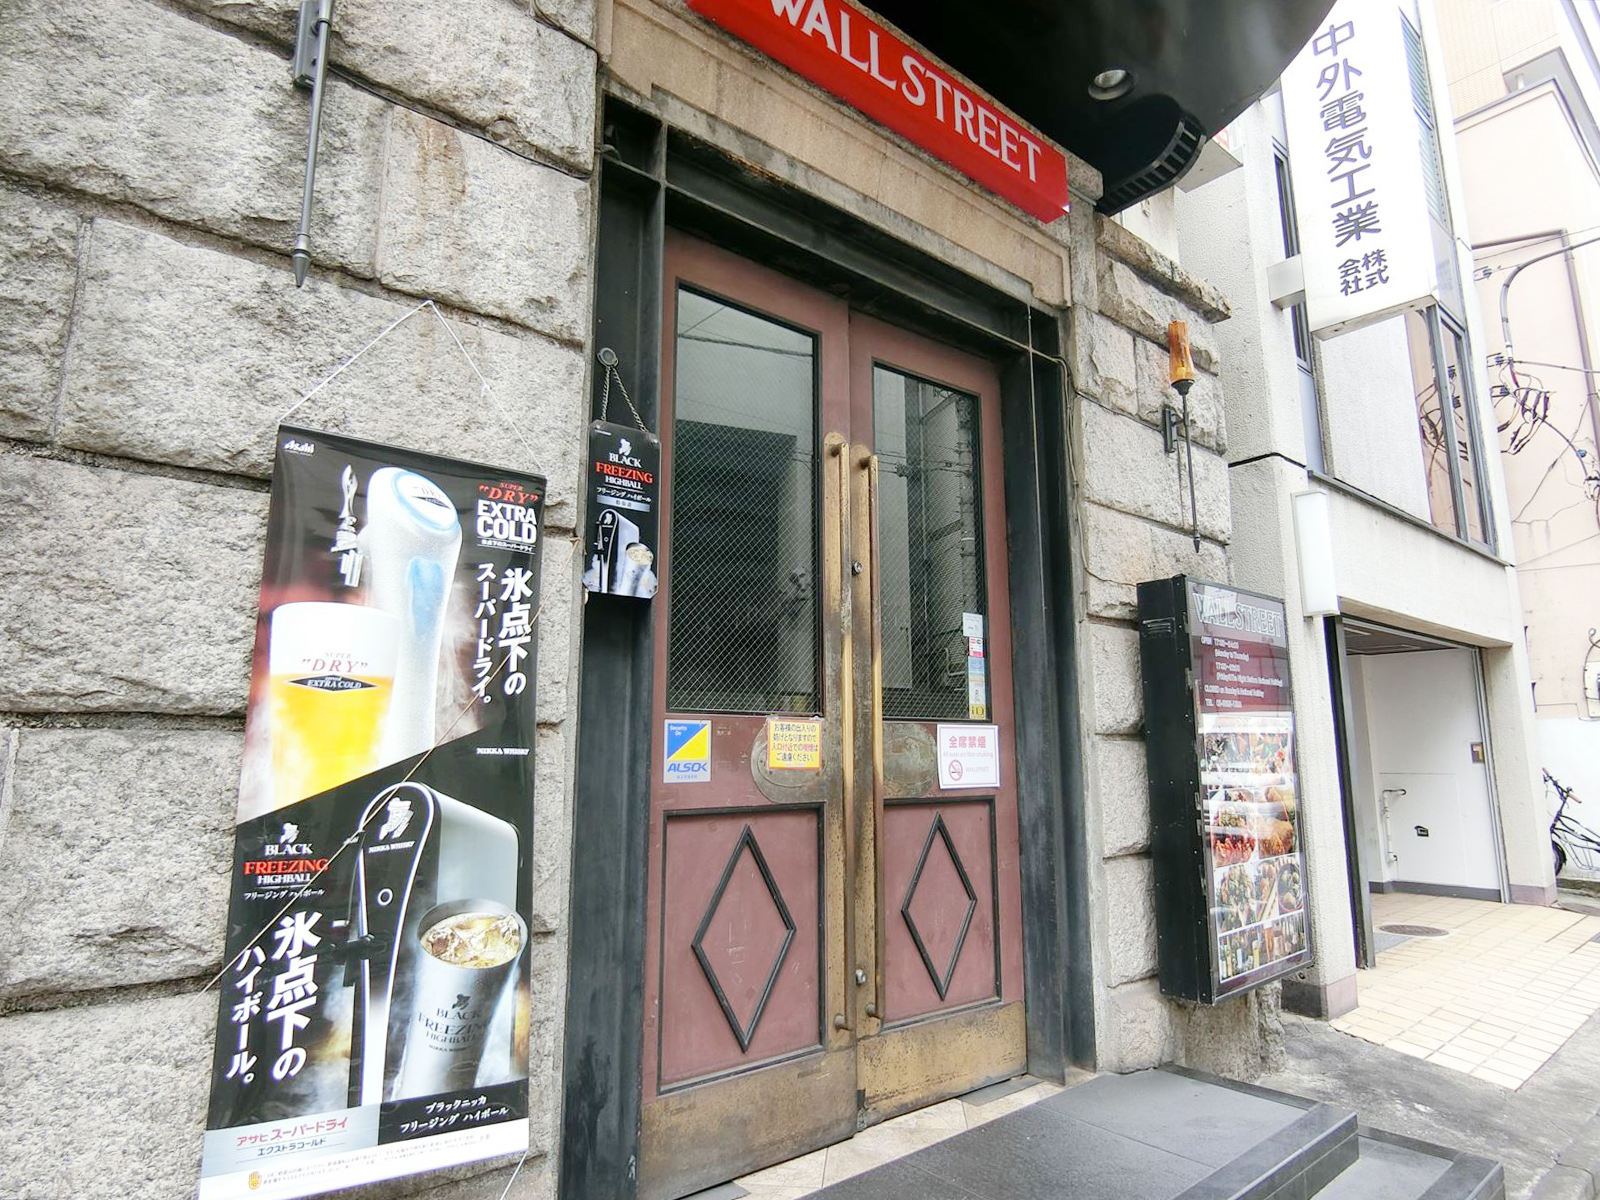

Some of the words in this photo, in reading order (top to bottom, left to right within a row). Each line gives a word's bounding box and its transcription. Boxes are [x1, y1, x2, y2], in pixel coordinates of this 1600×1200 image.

[902, 55, 1042, 183] STREET
[1311, 20, 1382, 248] 中外電気工業
[284, 439, 315, 454] Asahi
[609, 452, 642, 468] BLACK
[595, 461, 654, 484] FREEZING
[500, 481, 524, 491] SUPER
[605, 475, 644, 490] HIGHBALL
[477, 499, 537, 525] EXTRA
[477, 515, 537, 544] COLD
[1235, 602, 1282, 637] STREET
[471, 561, 498, 704] スーパードライ。
[498, 566, 534, 696] 氷点下の
[324, 651, 353, 659] SUPER
[306, 679, 338, 688] EXTRA
[338, 680, 362, 689] COLD
[948, 735, 987, 749] 全席禁煙
[476, 747, 503, 755] NIKKA
[503, 748, 530, 756] WHISKY
[667, 762, 708, 773] ALSOK
[264, 843, 314, 856] BLACK
[243, 858, 329, 875] FREEZING
[257, 873, 313, 885] HIGHBALL
[244, 889, 288, 900] フリージング
[266, 910, 324, 1081] 氷点下の
[226, 945, 267, 1084] ハイボール。
[424, 1094, 488, 1115] ブラックニッカ
[400, 1112, 460, 1134] フリージング
[461, 1105, 510, 1123] ハイボール
[257, 1137, 327, 1157] エクストラコールド
